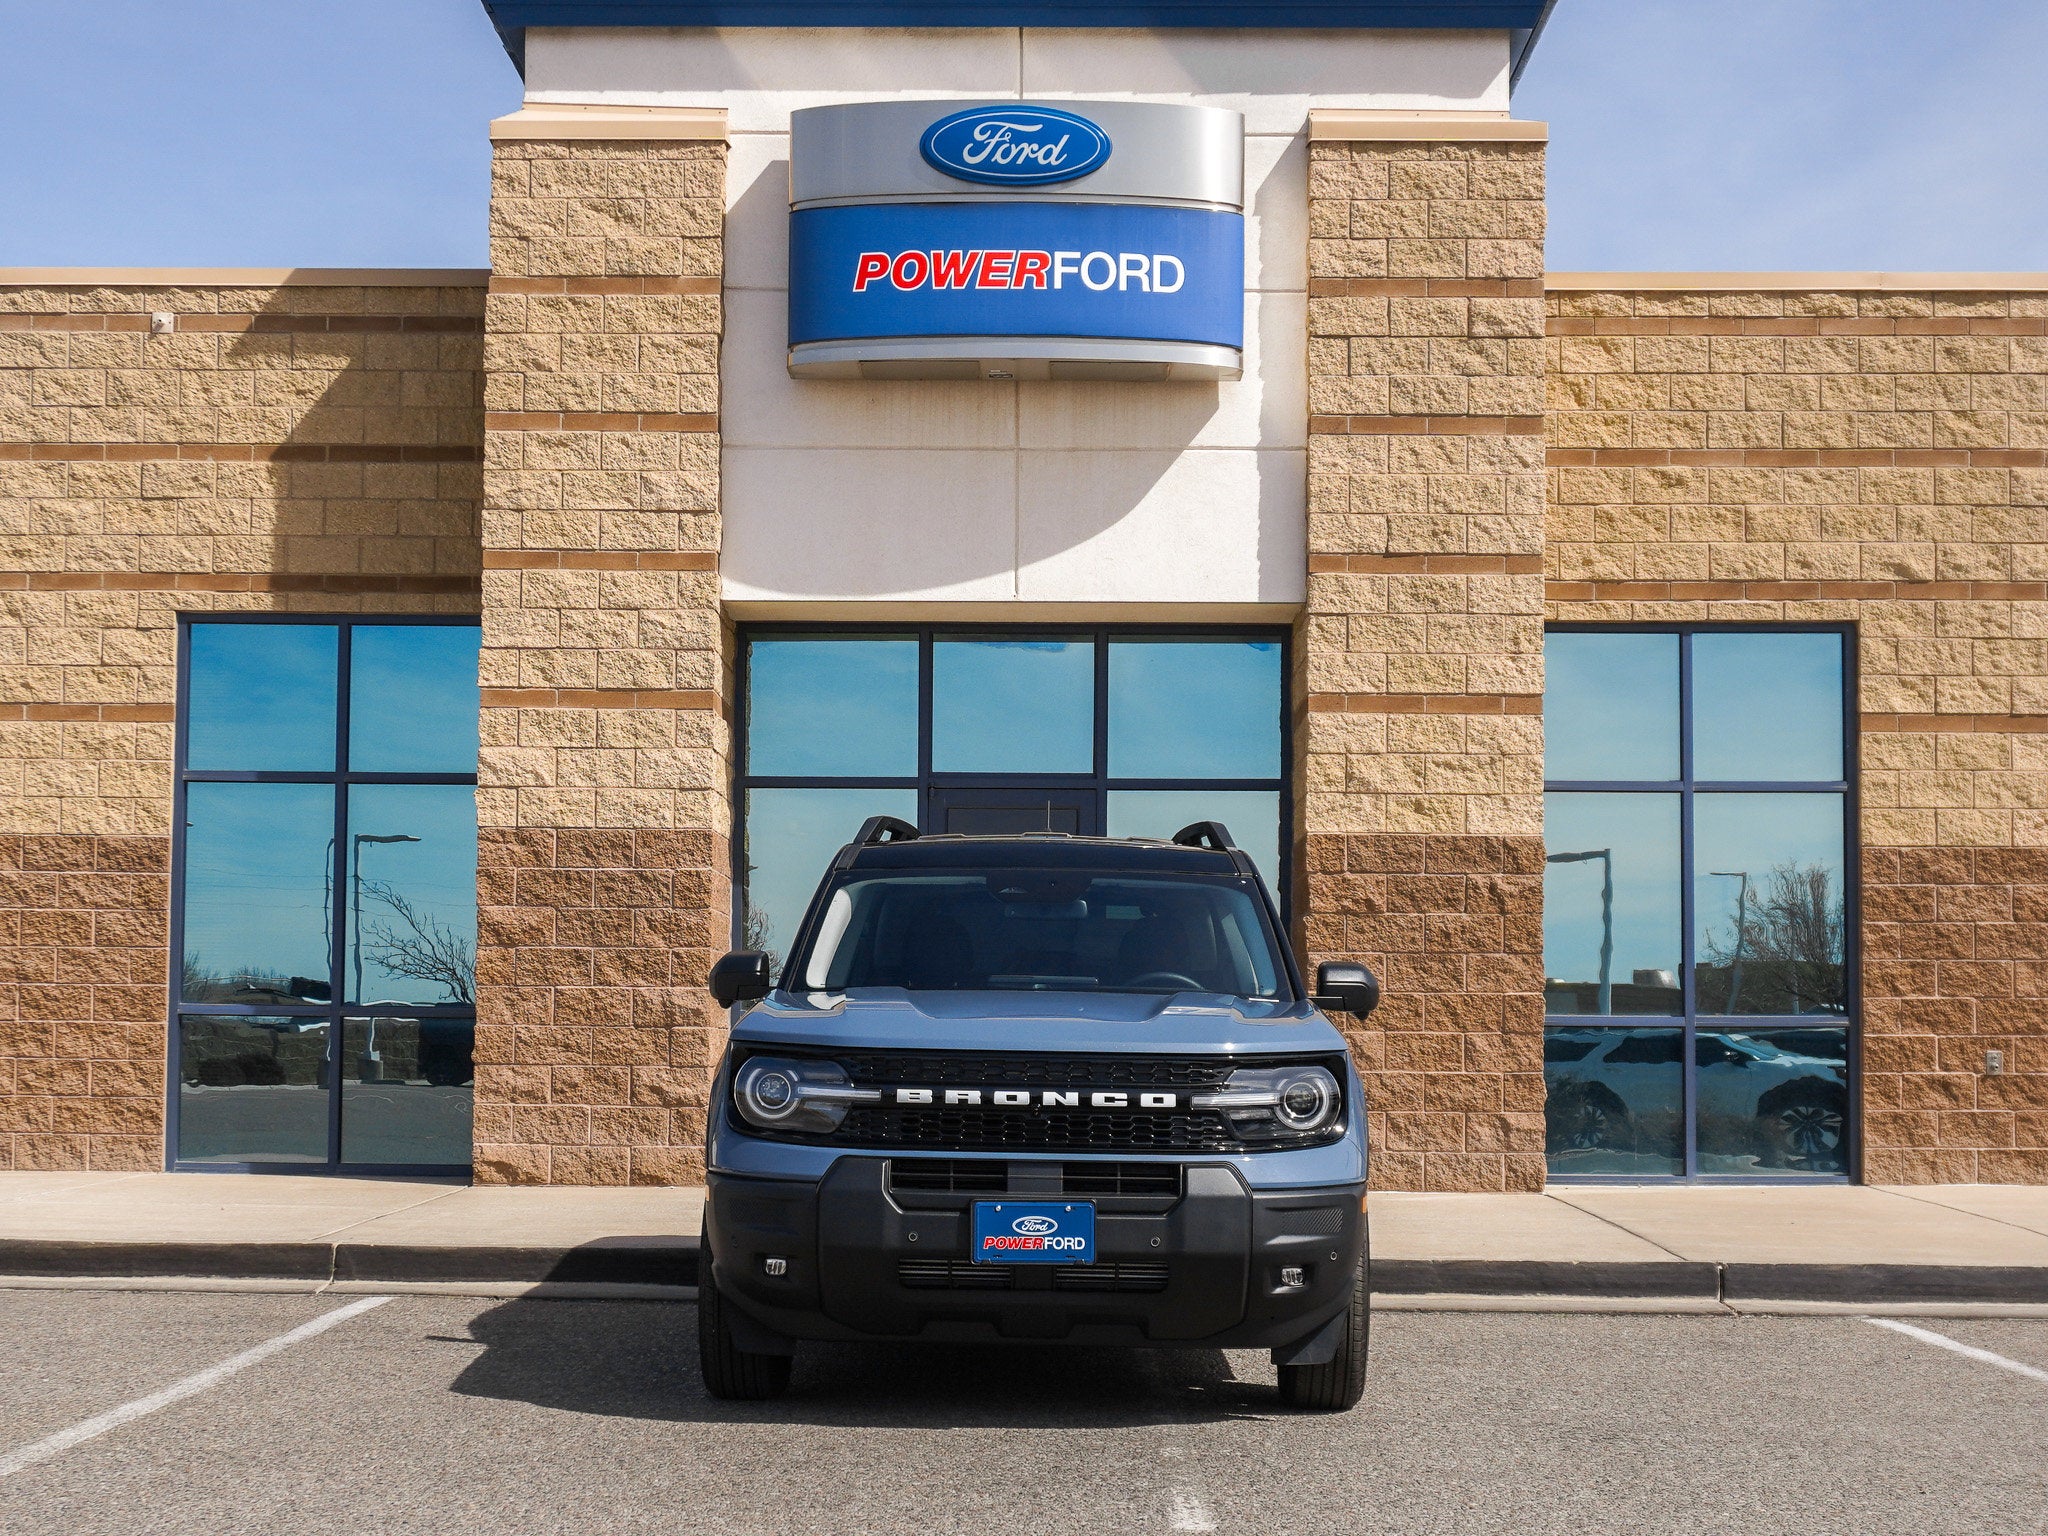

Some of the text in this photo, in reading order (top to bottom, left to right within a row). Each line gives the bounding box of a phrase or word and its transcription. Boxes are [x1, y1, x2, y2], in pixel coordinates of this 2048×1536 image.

[962, 121, 1070, 166] Ford
[896, 1088, 1177, 1108] BRONCO
[1021, 1219, 1049, 1232] Ford
